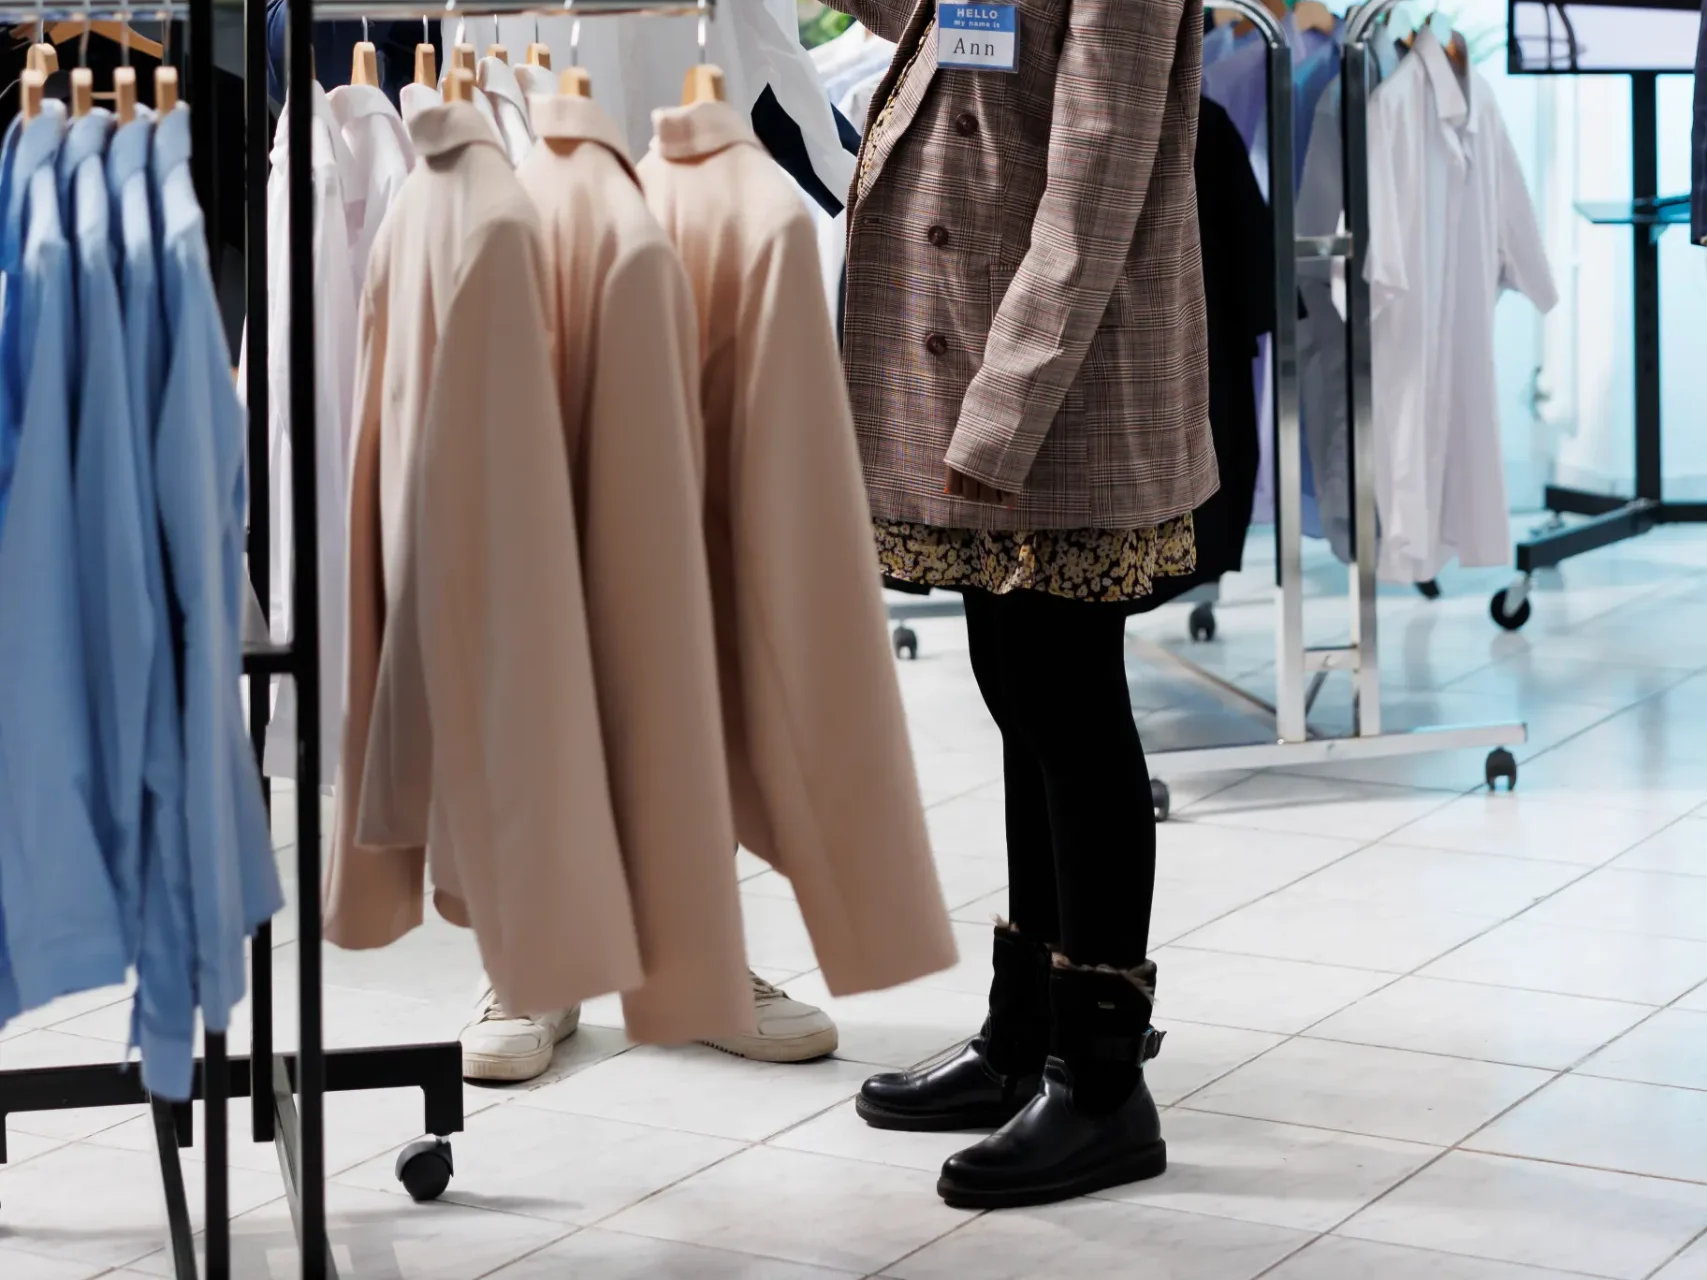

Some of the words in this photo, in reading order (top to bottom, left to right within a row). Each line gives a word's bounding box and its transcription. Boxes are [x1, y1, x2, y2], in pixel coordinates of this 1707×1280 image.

[957, 8, 998, 19] HELLO
[953, 19, 965, 27] my
[953, 37, 995, 56] Ann
